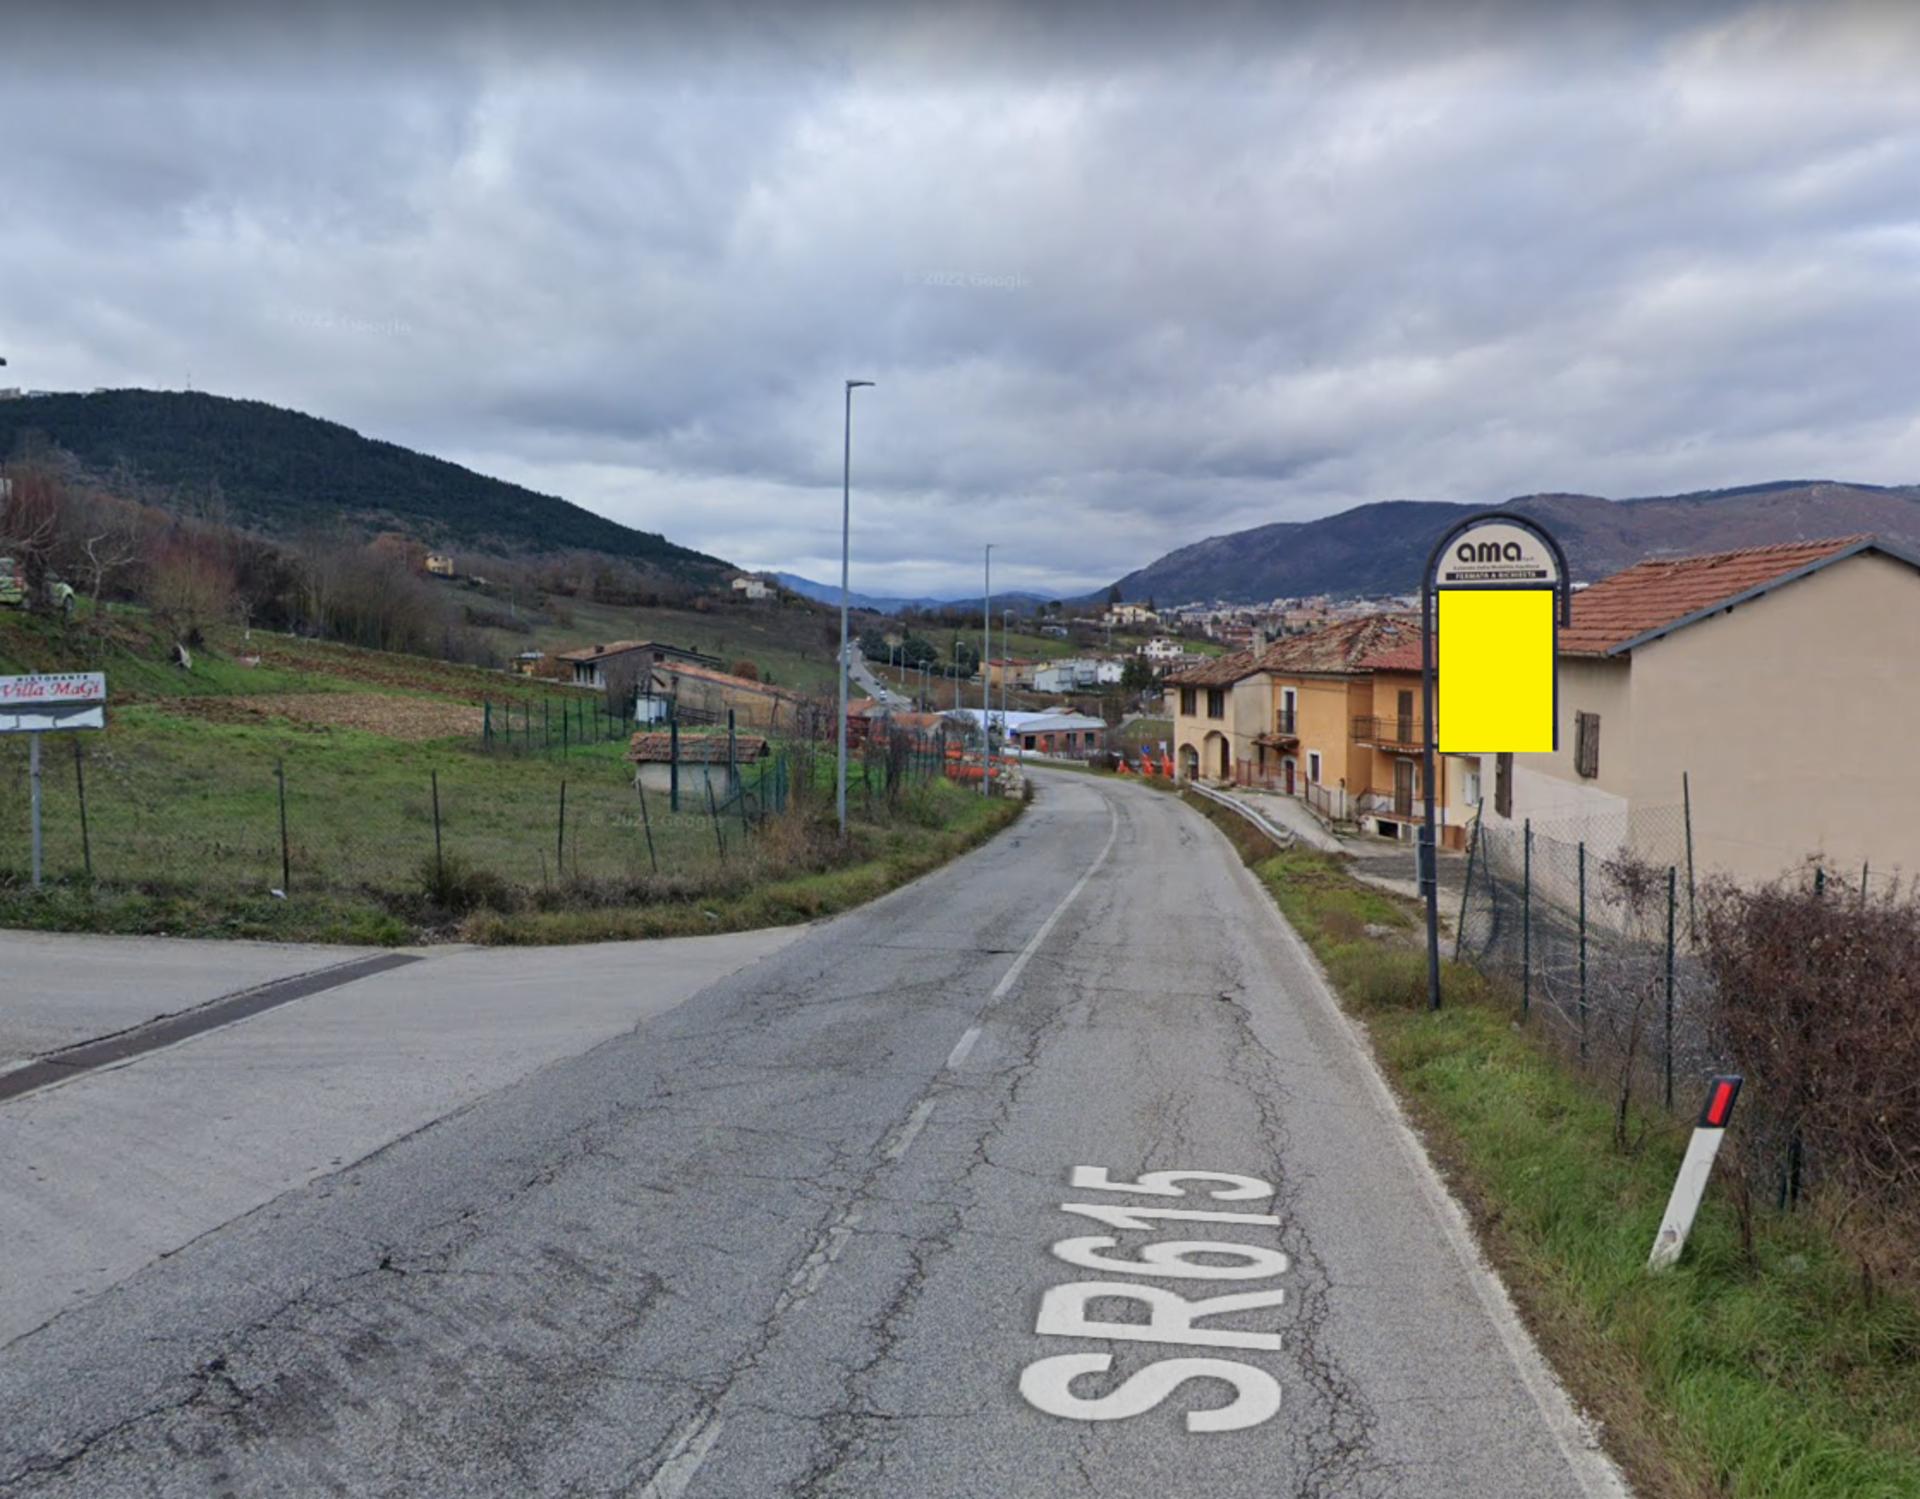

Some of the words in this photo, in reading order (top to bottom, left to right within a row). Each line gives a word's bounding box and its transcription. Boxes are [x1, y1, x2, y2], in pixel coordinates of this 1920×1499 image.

[1457, 542, 1521, 562] ama
[3, 681, 44, 697] Villa
[48, 680, 100, 698] MaGi
[1019, 1165, 1289, 1432] SR615
